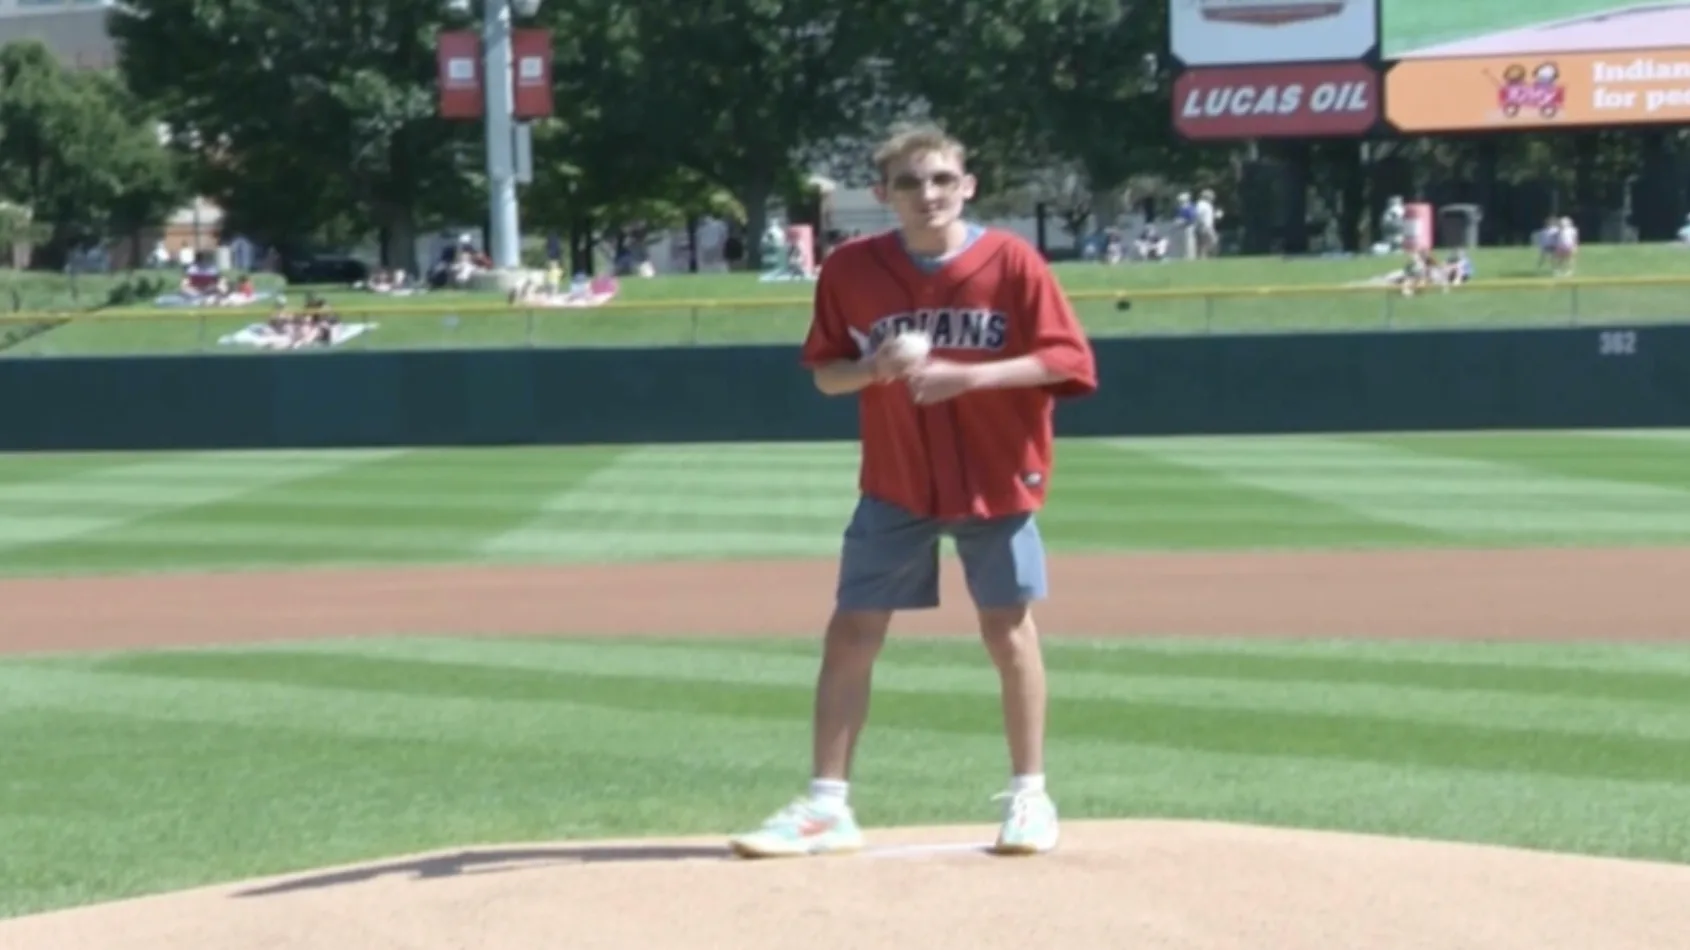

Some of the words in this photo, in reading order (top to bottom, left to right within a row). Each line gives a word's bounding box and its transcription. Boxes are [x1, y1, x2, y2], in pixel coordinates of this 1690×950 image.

[1182, 84, 1303, 117] LUCAS
[1309, 81, 1369, 112] OIL
[1593, 88, 1636, 109] for
